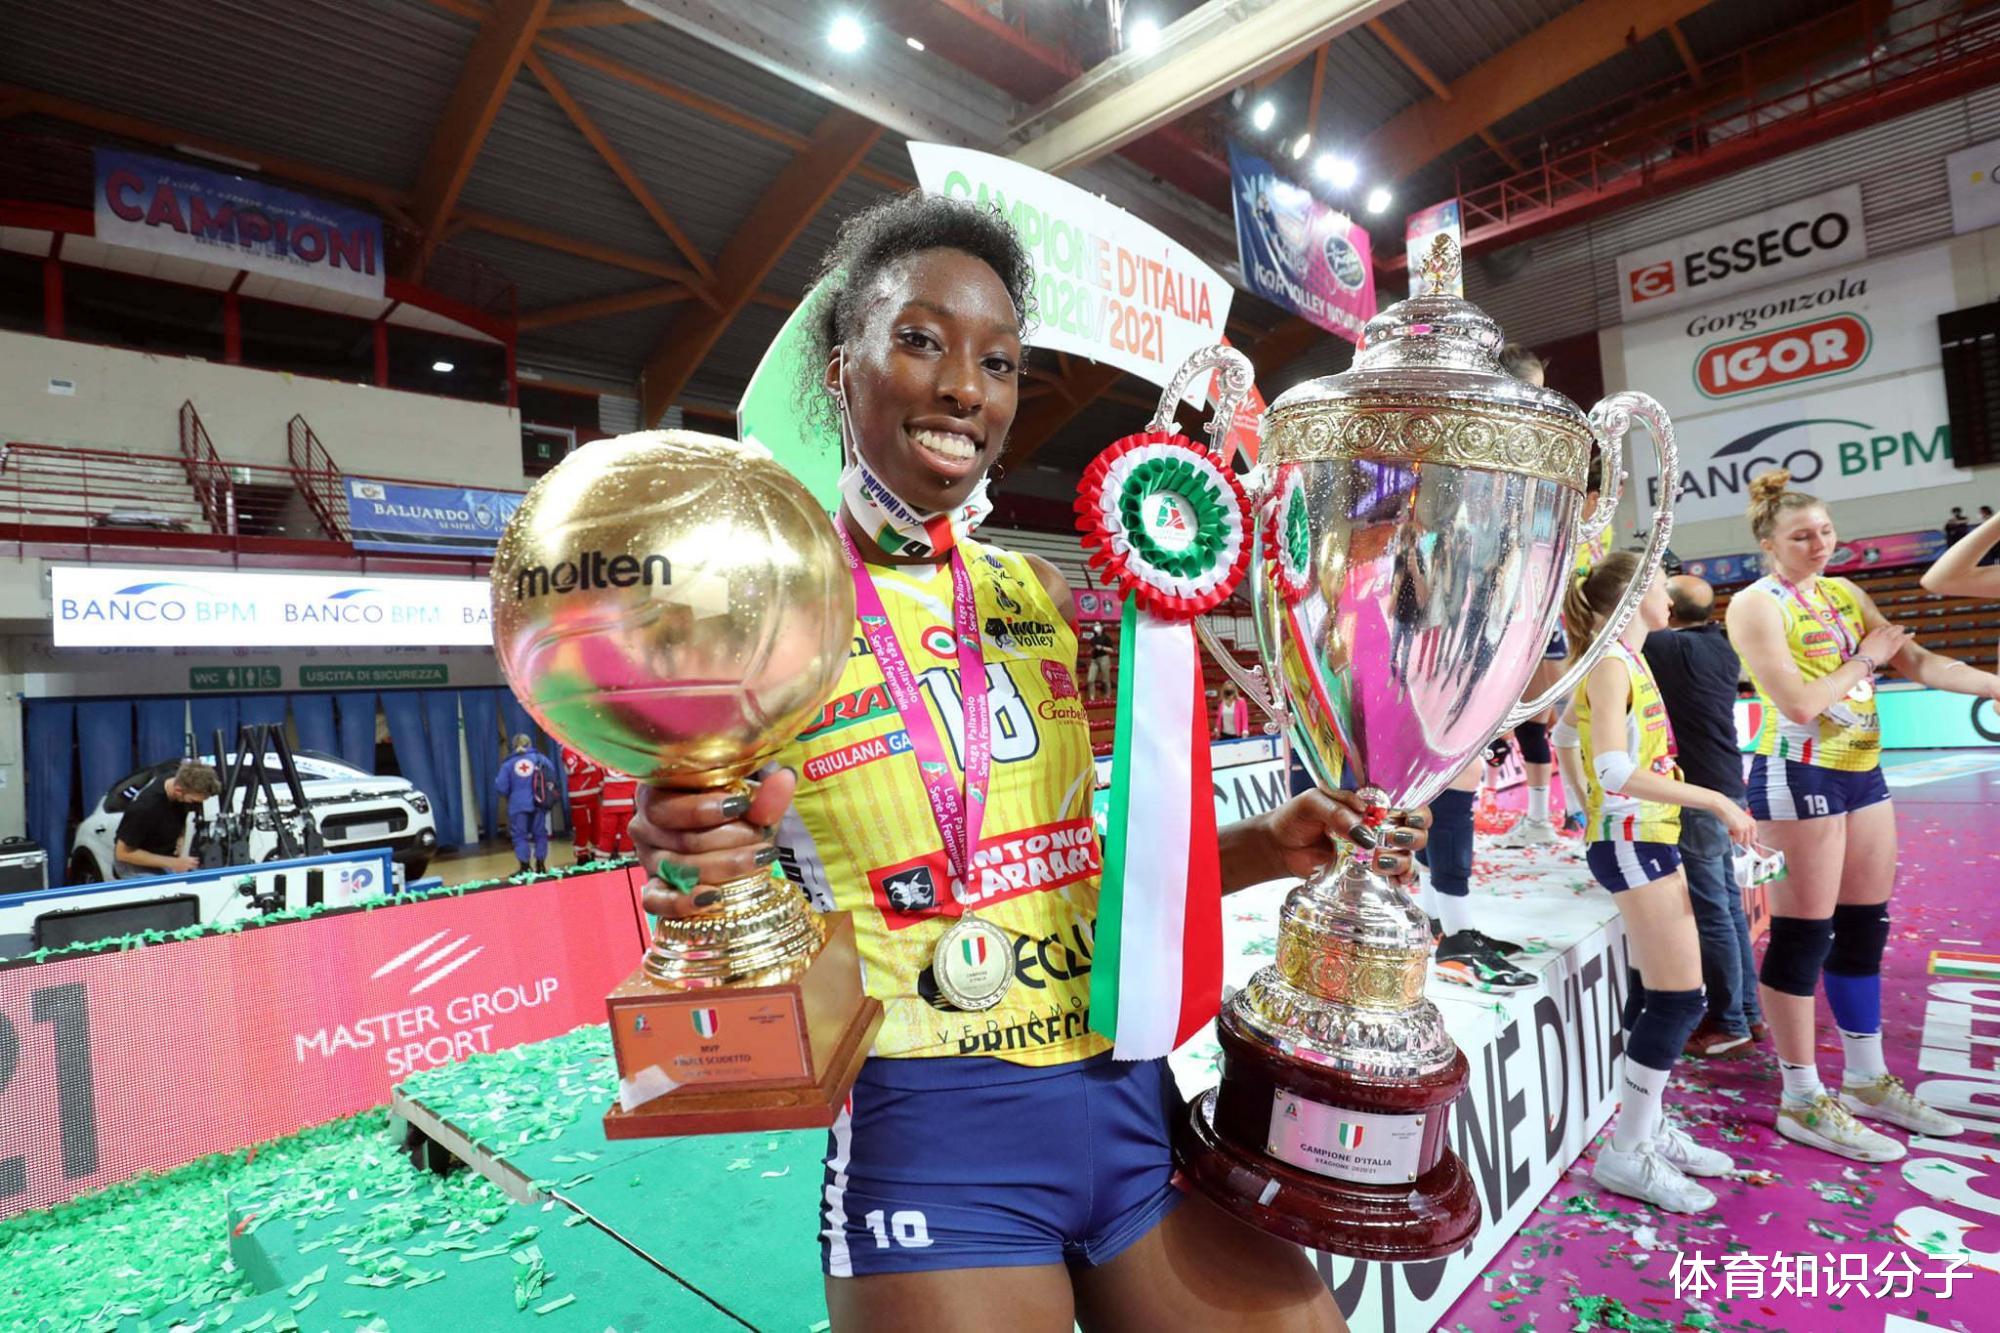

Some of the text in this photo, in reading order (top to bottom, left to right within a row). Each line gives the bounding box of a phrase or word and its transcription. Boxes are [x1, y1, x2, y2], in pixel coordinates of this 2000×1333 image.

[105, 168, 376, 276] CAMPIONI
[1685, 212, 1849, 288] ESSECO
[1117, 246, 1213, 329] D'ITALIA
[1686, 277, 1868, 338] Gorgonzola
[1028, 273, 1164, 363] 020/2021
[1712, 328, 1849, 388] IGOR
[1838, 424, 1955, 477] BPM
[859, 464, 900, 513] AMPIONI
[374, 503, 469, 521] BALUARDO
[517, 551, 672, 600] molten
[61, 599, 186, 622] BANCO
[196, 601, 257, 622] BPM
[284, 604, 383, 625] BANCO
[391, 605, 440, 624] BPM
[958, 607, 967, 625] Lega
[1015, 634, 1053, 648] Volley
[193, 671, 220, 685] WC
[305, 666, 444, 683] USCITA DI SICUREZZA
[871, 634, 884, 657] Serie
[885, 665, 908, 711] Femminile
[884, 635, 918, 703] Lega Pallavolo
[966, 696, 979, 770] Lega Pallavolo
[978, 694, 989, 739] Femminile
[807, 733, 912, 778] FRIULANA GA
[979, 752, 989, 778] Serie
[943, 787, 957, 814] Lega
[1803, 794, 1829, 815] 19
[930, 785, 943, 815] Serie
[942, 823, 963, 875] Femminile
[1650, 857, 1662, 873] 1
[295, 976, 559, 1063] MASTER GROUP
[937, 996, 1083, 1044] VEDIAMO
[386, 1024, 495, 1077] SPORT
[700, 1045, 719, 1053] MVP
[705, 1055, 751, 1066] SCUDETTO
[1300, 1143, 1392, 1167] CAMPIONE D'ITALIA
[1315, 1158, 1349, 1171] STAGIONE
